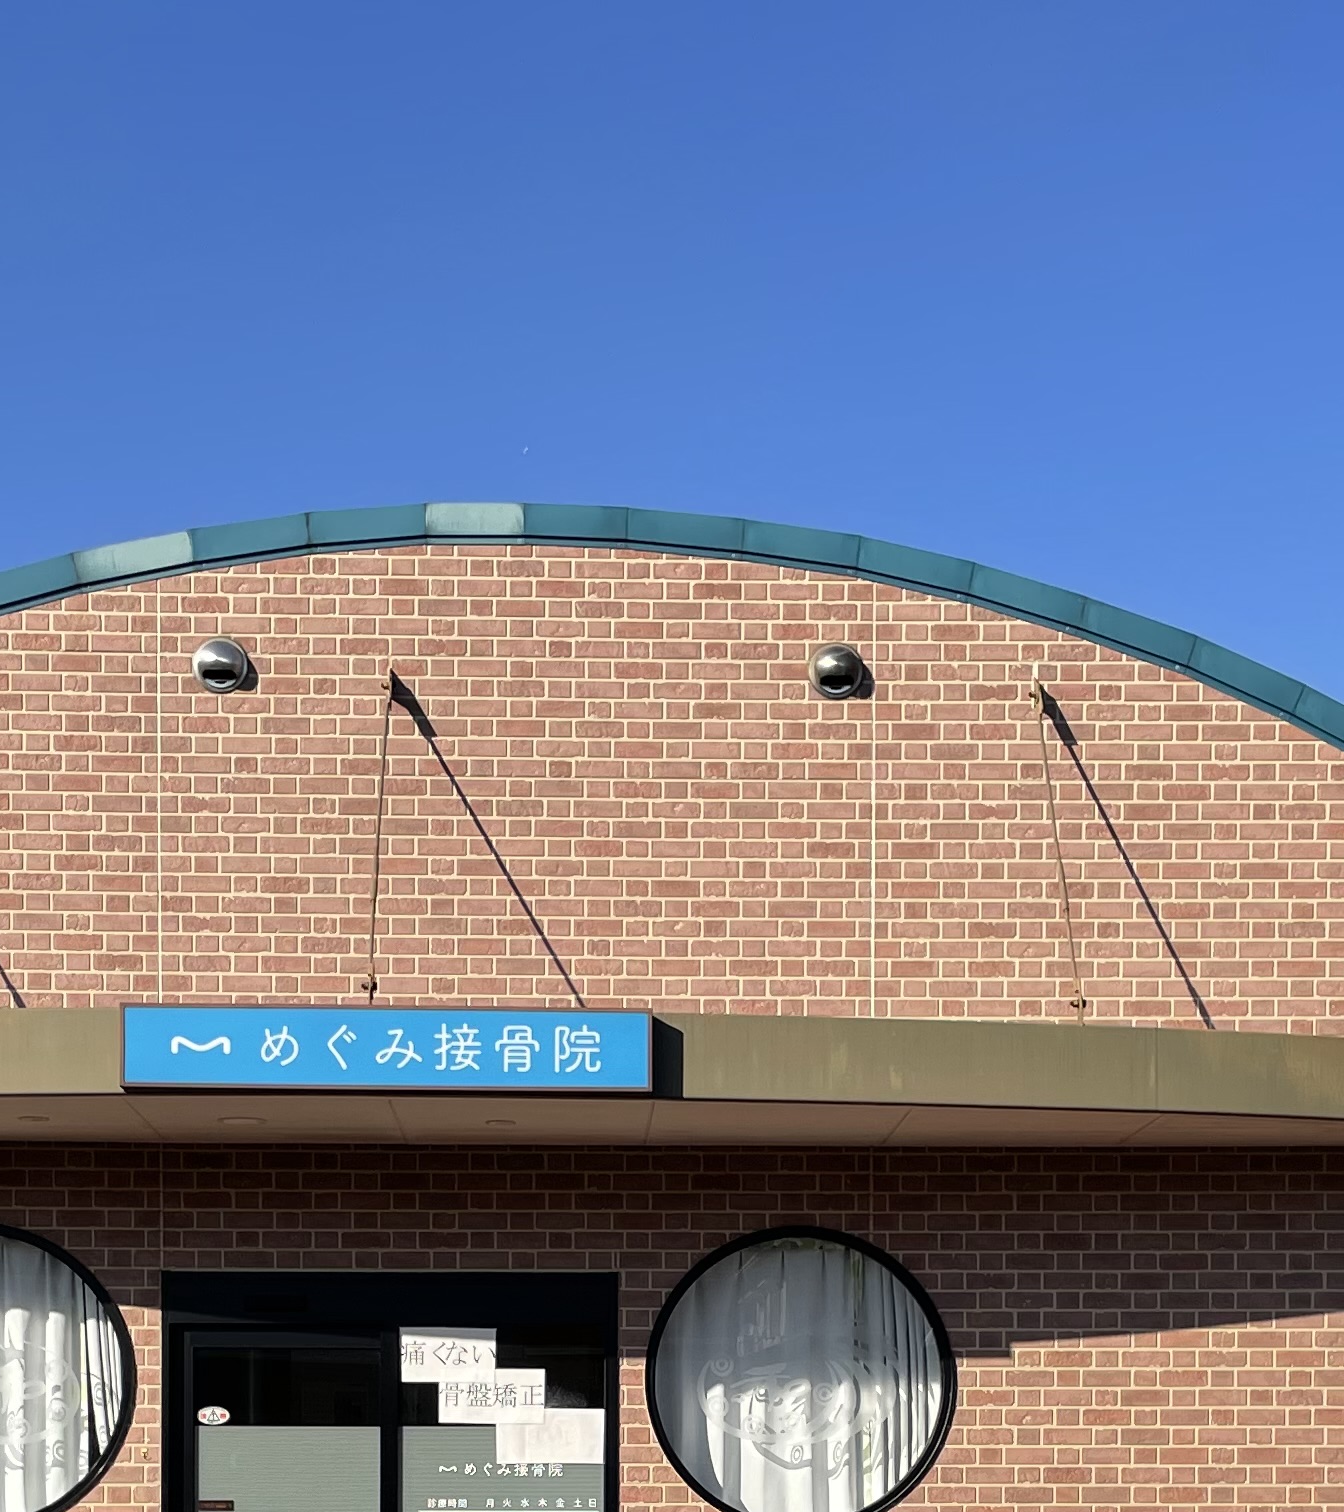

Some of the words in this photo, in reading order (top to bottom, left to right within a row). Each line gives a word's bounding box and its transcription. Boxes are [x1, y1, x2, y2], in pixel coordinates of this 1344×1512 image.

[260, 1023, 603, 1074] めぐみ接骨院
[400, 1340, 497, 1367] 痛くない
[439, 1382, 545, 1409] 骨盤矯正
[464, 1463, 564, 1477] めぐみ接骨院
[485, 1498, 495, 1508] 月
[502, 1498, 512, 1508] 火
[520, 1498, 530, 1508] 水
[537, 1498, 548, 1508] 木
[555, 1498, 565, 1508] 金
[573, 1498, 583, 1508] 土
[588, 1498, 597, 1508] 日
